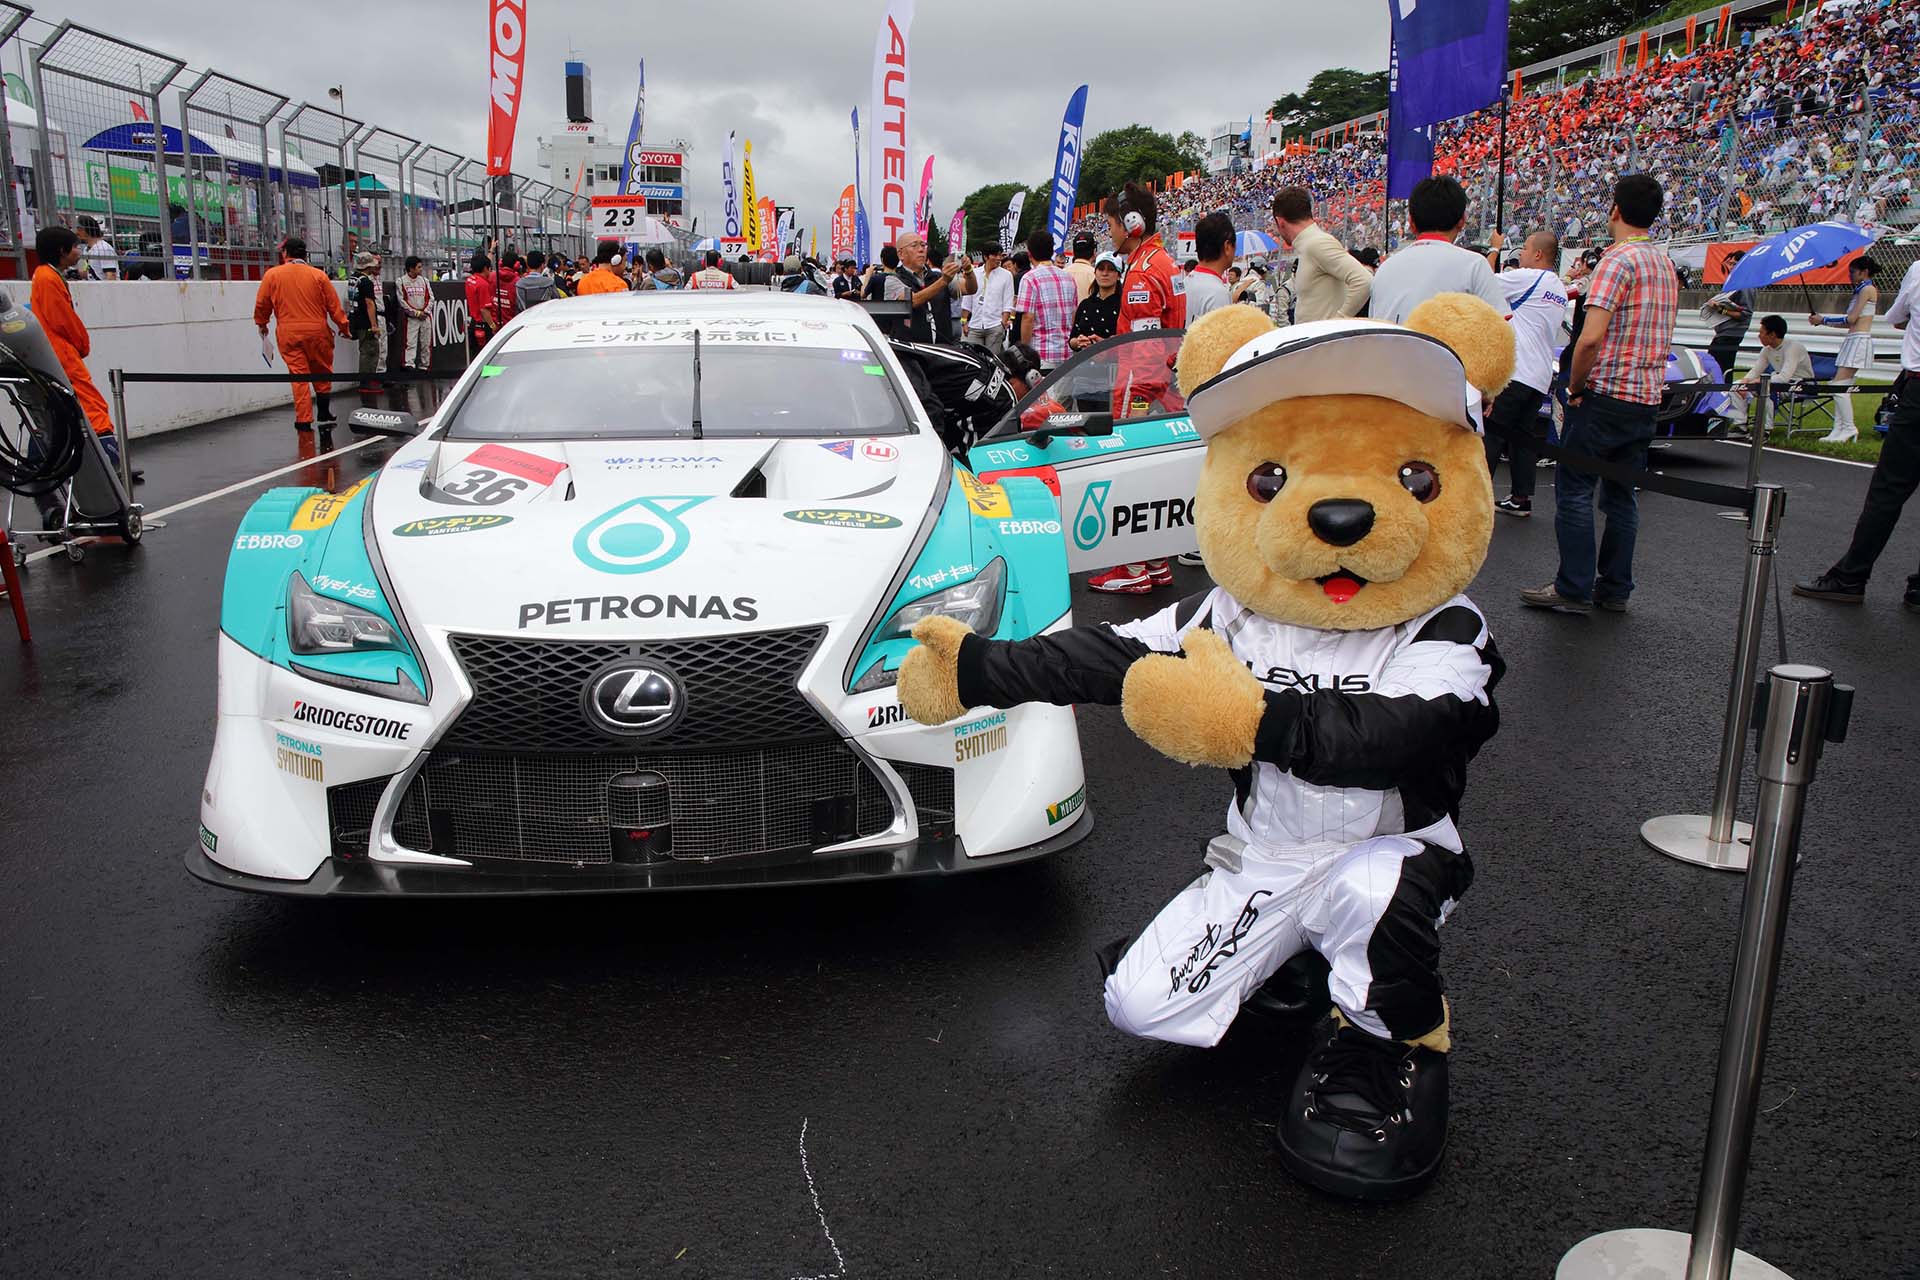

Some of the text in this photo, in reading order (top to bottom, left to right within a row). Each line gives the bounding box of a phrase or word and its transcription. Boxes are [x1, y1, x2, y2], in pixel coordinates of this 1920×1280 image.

[882, 14, 905, 248] AUTECH
[640, 154, 676, 164] OYOTA
[722, 161, 739, 238] EPSO
[744, 165, 757, 246] DUNLOP
[603, 208, 635, 227] 23
[759, 207, 770, 250] ENEOS
[841, 197, 850, 247] ENEOS
[726, 243, 742, 253] 37
[1780, 230, 1819, 264] 100
[602, 319, 692, 327] LEXUS
[987, 446, 1030, 465] ENG
[444, 469, 529, 505] 36
[404, 516, 503, 533] バンテリン
[428, 526, 471, 536] VANTELIN
[796, 510, 891, 524] バンテリン
[823, 519, 865, 528] VANTELIN
[519, 593, 759, 629] PETRONAS
[293, 701, 413, 740] BRIDGESTONE
[954, 711, 1007, 738] PETRONAS
[276, 732, 322, 756] PETRONAS
[955, 725, 1008, 763] SYNTIUM
[276, 746, 324, 783] SYNTIUM
[1187, 889, 1274, 994] LEXUS
[1167, 922, 1222, 1001] Racing
